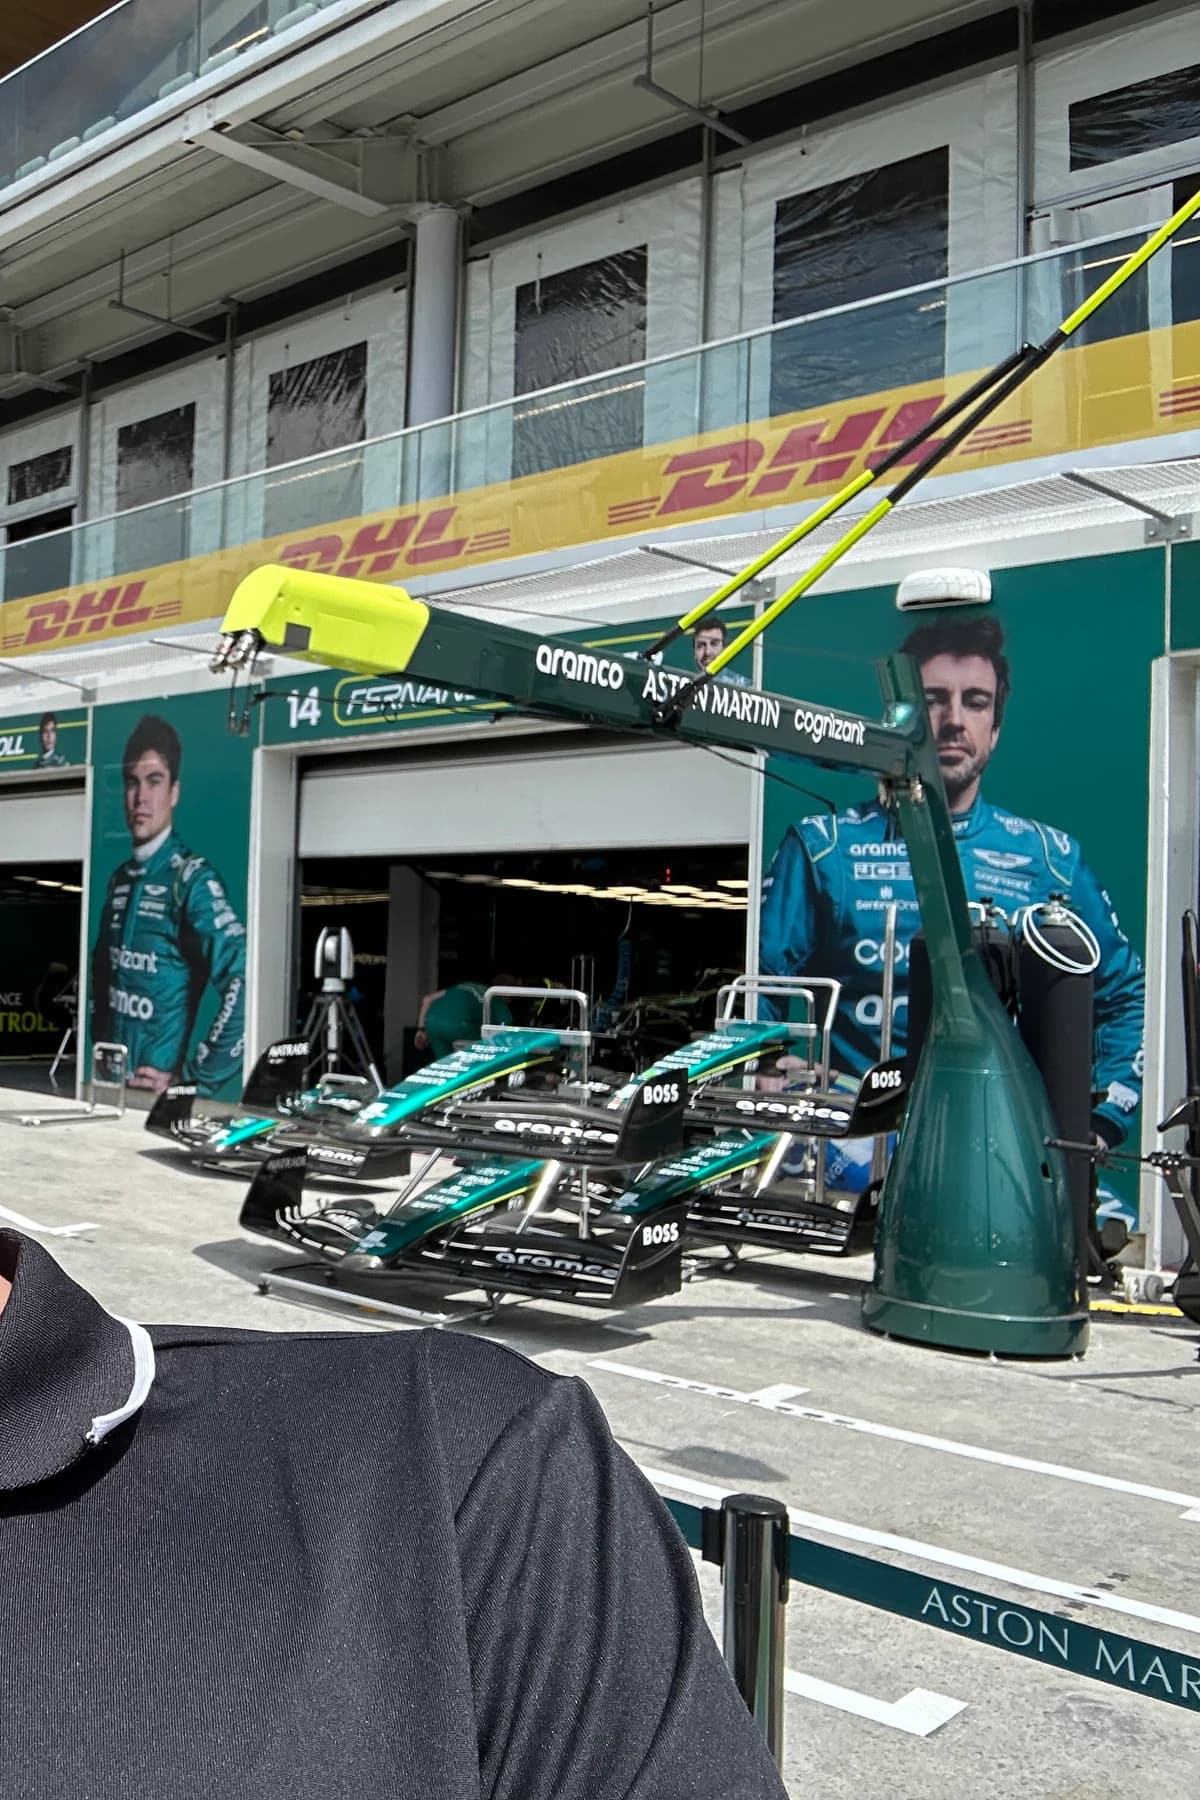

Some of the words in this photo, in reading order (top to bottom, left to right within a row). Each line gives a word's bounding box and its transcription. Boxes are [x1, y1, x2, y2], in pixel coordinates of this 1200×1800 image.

[656, 394, 952, 515] DHL
[279, 506, 470, 577] DHL
[25, 580, 153, 645] DHL
[536, 644, 624, 691] aramco
[288, 686, 321, 728] 14
[711, 685, 780, 729] MARTIN
[794, 708, 866, 746] cognizant
[850, 842, 908, 857] aramc
[643, 1083, 680, 1105] BOSS
[871, 1069, 902, 1089] BOSS
[736, 1100, 851, 1122] aramco
[494, 1119, 619, 1143] aramco
[642, 1222, 679, 1246] BOSS
[495, 1252, 620, 1279] aramco
[921, 1587, 1069, 1661] ASTON
